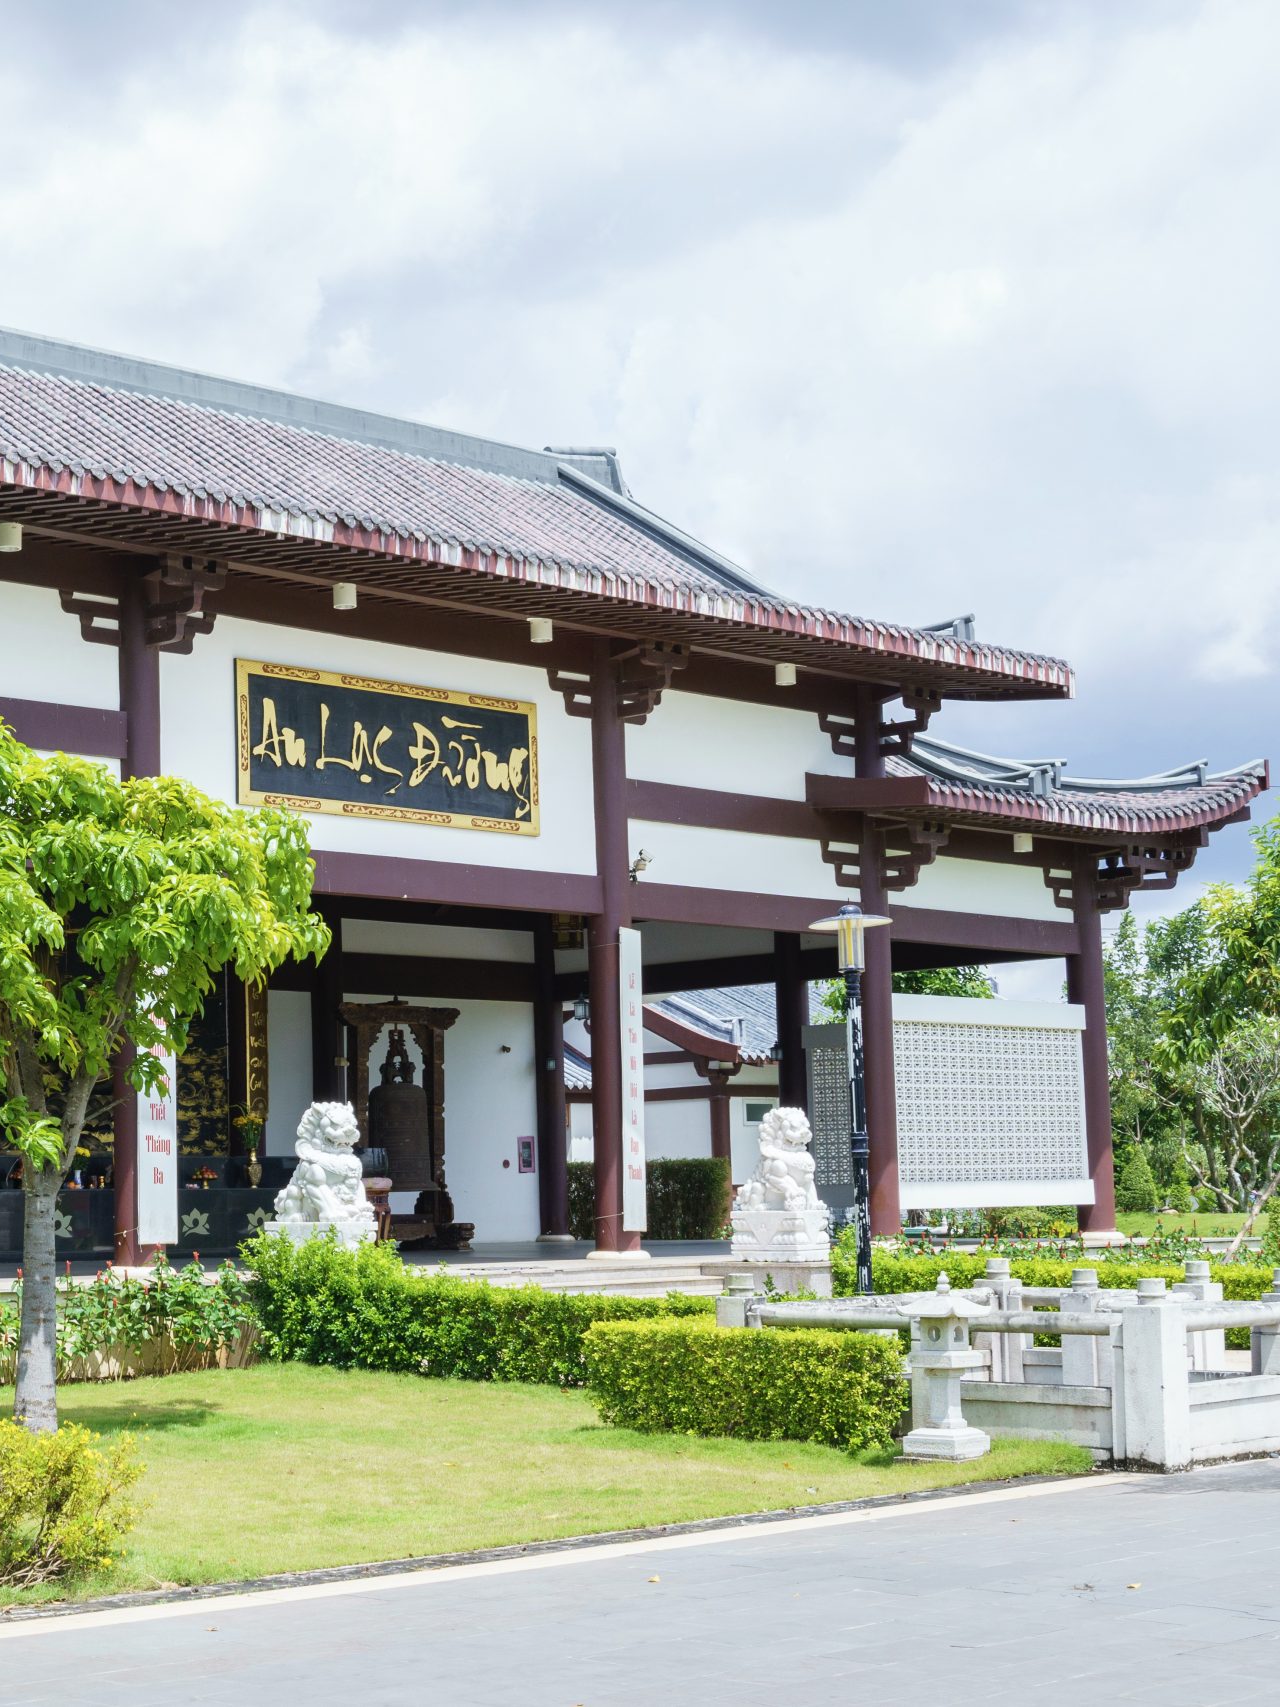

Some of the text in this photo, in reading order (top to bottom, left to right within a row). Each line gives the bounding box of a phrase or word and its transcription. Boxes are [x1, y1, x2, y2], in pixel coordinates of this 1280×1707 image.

[252, 697, 307, 768] An
[315, 703, 404, 795] Lạc
[149, 1103, 166, 1121] Tiết
[145, 1135, 171, 1156] Tháng
[153, 1166, 164, 1185] Ba
